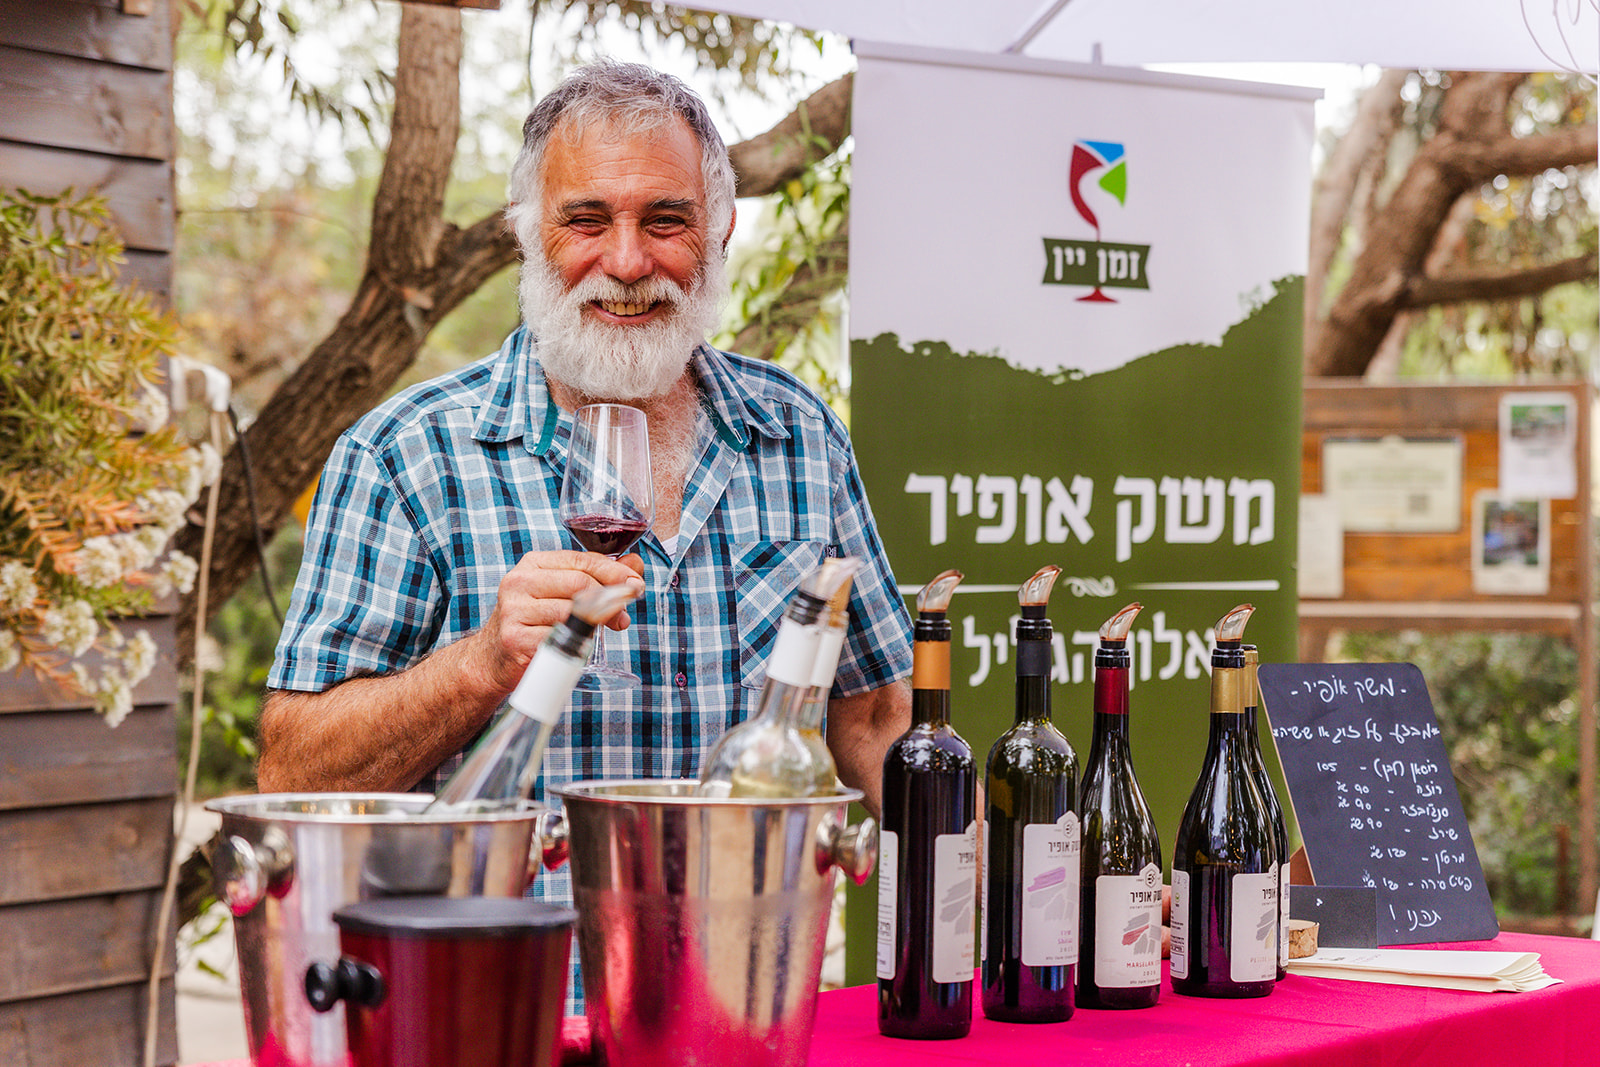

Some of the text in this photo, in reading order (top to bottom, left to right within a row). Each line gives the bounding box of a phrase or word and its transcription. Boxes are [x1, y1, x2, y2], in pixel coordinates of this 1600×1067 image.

[1053, 246, 1140, 284] זמן יין
[904, 473, 1275, 563] משק אופיר
[1354, 677, 1395, 704] משק
[1318, 725, 1330, 738] או
[1332, 725, 1361, 744] זוג
[1365, 718, 1383, 742] על
[1316, 762, 1338, 772] 105
[1354, 783, 1369, 795] 90
[1355, 798, 1371, 810] 90
[1366, 817, 1382, 830] 90
[1428, 827, 1459, 841] שירז
[1387, 847, 1407, 859] 120
[1434, 849, 1465, 875] מרסלן
[1382, 877, 1399, 891] 120
[1129, 891, 1152, 903] אופיר
